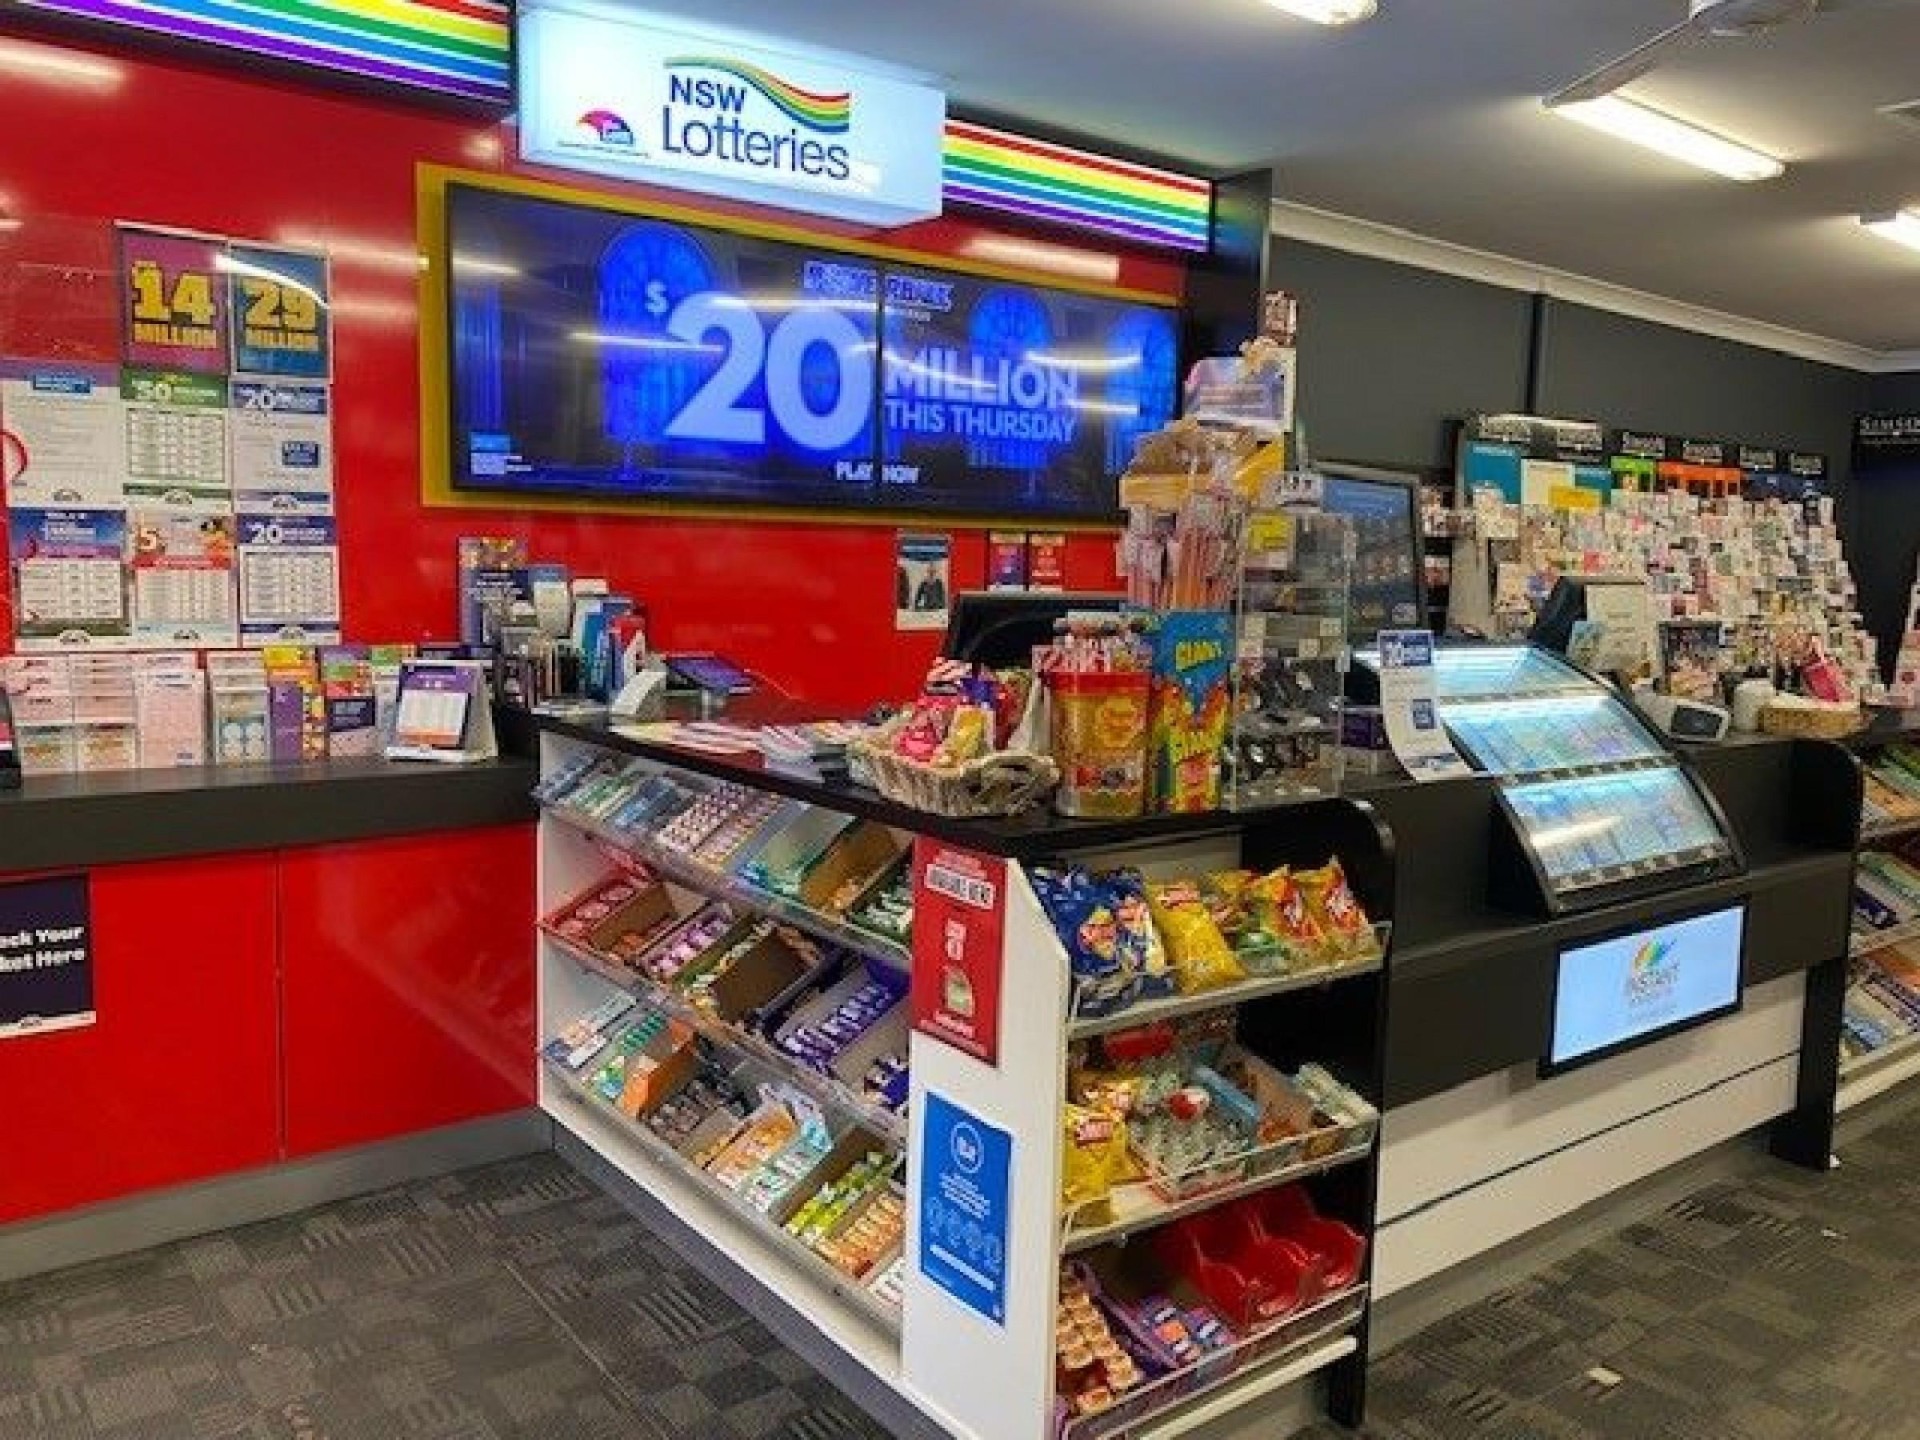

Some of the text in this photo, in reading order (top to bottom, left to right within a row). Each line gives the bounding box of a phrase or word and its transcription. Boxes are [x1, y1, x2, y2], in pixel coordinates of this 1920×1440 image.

[668, 74, 747, 114] NSW
[662, 104, 850, 180] Lotteries
[131, 260, 217, 323] 14
[241, 277, 316, 327] 29
[886, 346, 1079, 411] MILLION
[886, 401, 1078, 443] THIS THURSDAY
[36, 927, 84, 942] Your
[36, 948, 84, 967] Here
